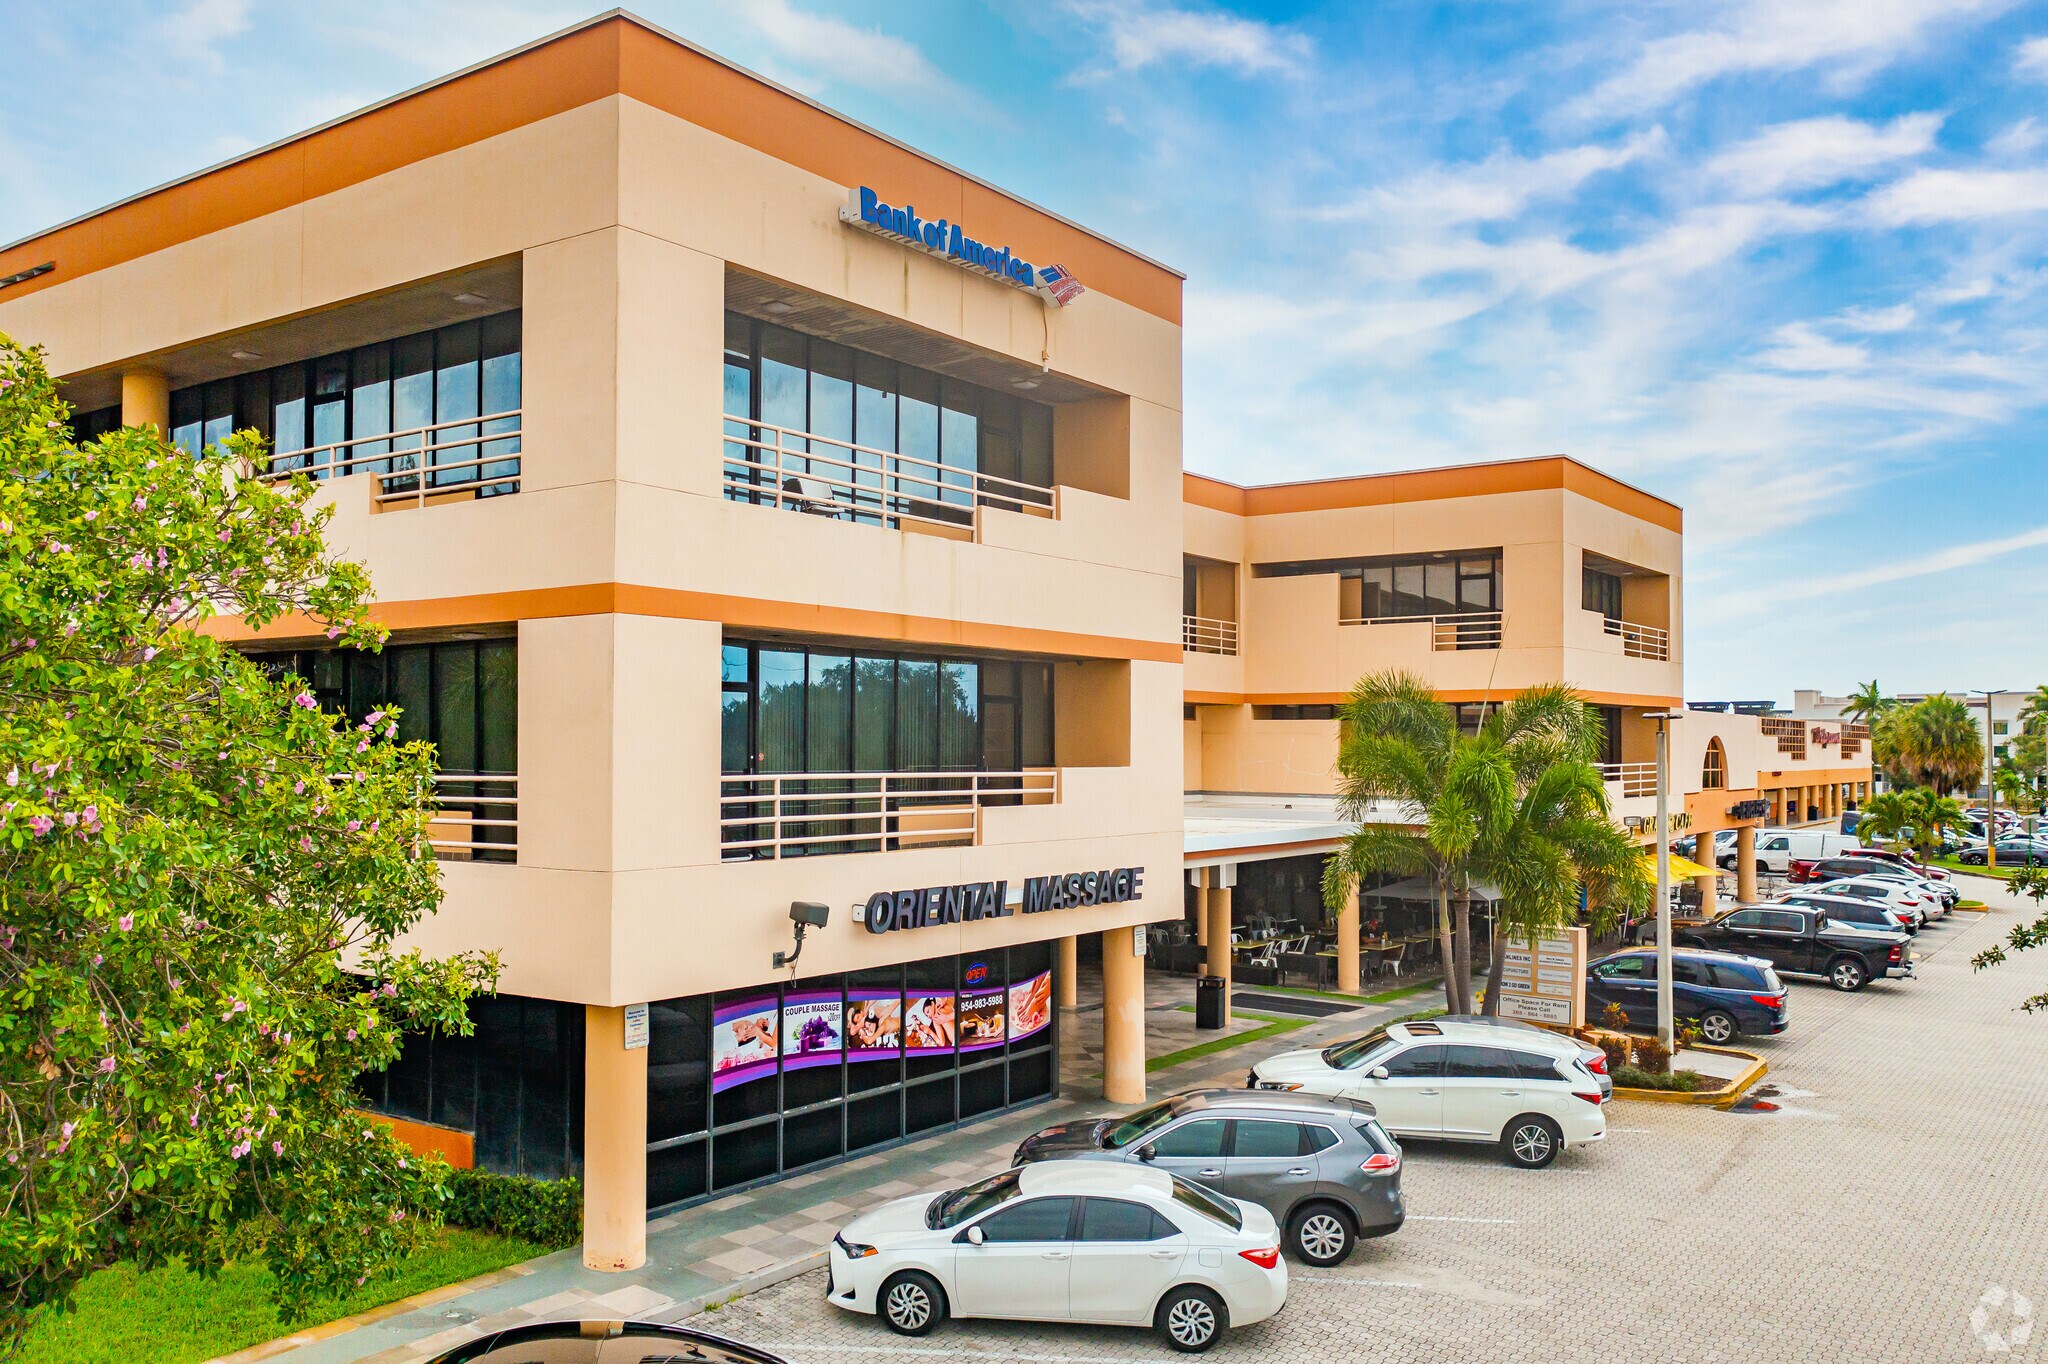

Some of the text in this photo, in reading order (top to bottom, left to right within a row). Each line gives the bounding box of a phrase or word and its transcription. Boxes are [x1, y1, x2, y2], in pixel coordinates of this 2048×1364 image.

[860, 186, 1034, 287] Bank of America
[1675, 812, 1693, 831] CAFE
[864, 866, 1145, 935] ORIENTAL MASSAGE
[966, 967, 988, 981] OPEN
[785, 1003, 840, 1016] COUPLE MASSAGE
